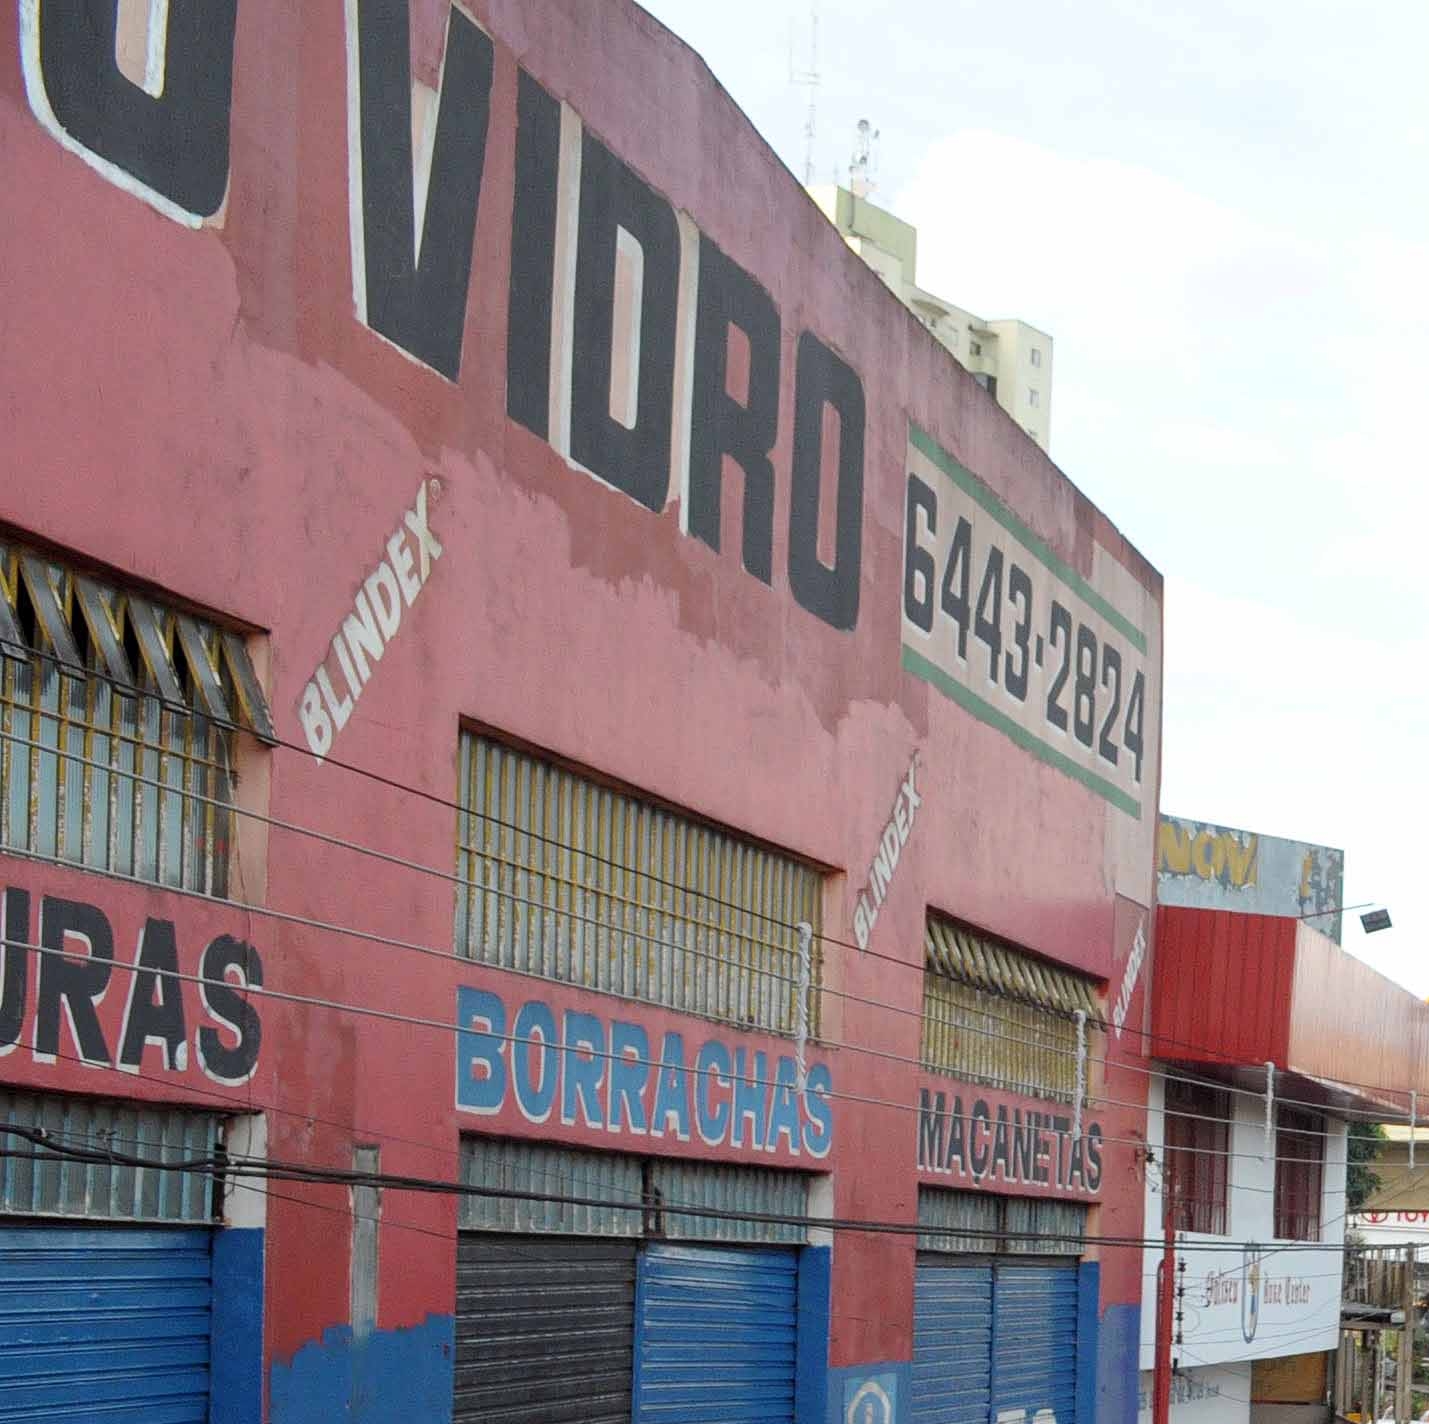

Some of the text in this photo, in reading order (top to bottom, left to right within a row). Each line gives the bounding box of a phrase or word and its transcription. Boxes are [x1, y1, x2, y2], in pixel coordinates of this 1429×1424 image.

[345, 0, 867, 633] VIDRO
[299, 479, 442, 767] BLINDEX
[853, 764, 923, 952] BLINDEX
[455, 984, 834, 1159] BORRACHAS
[916, 1088, 1103, 1194] MAÇANETAS
